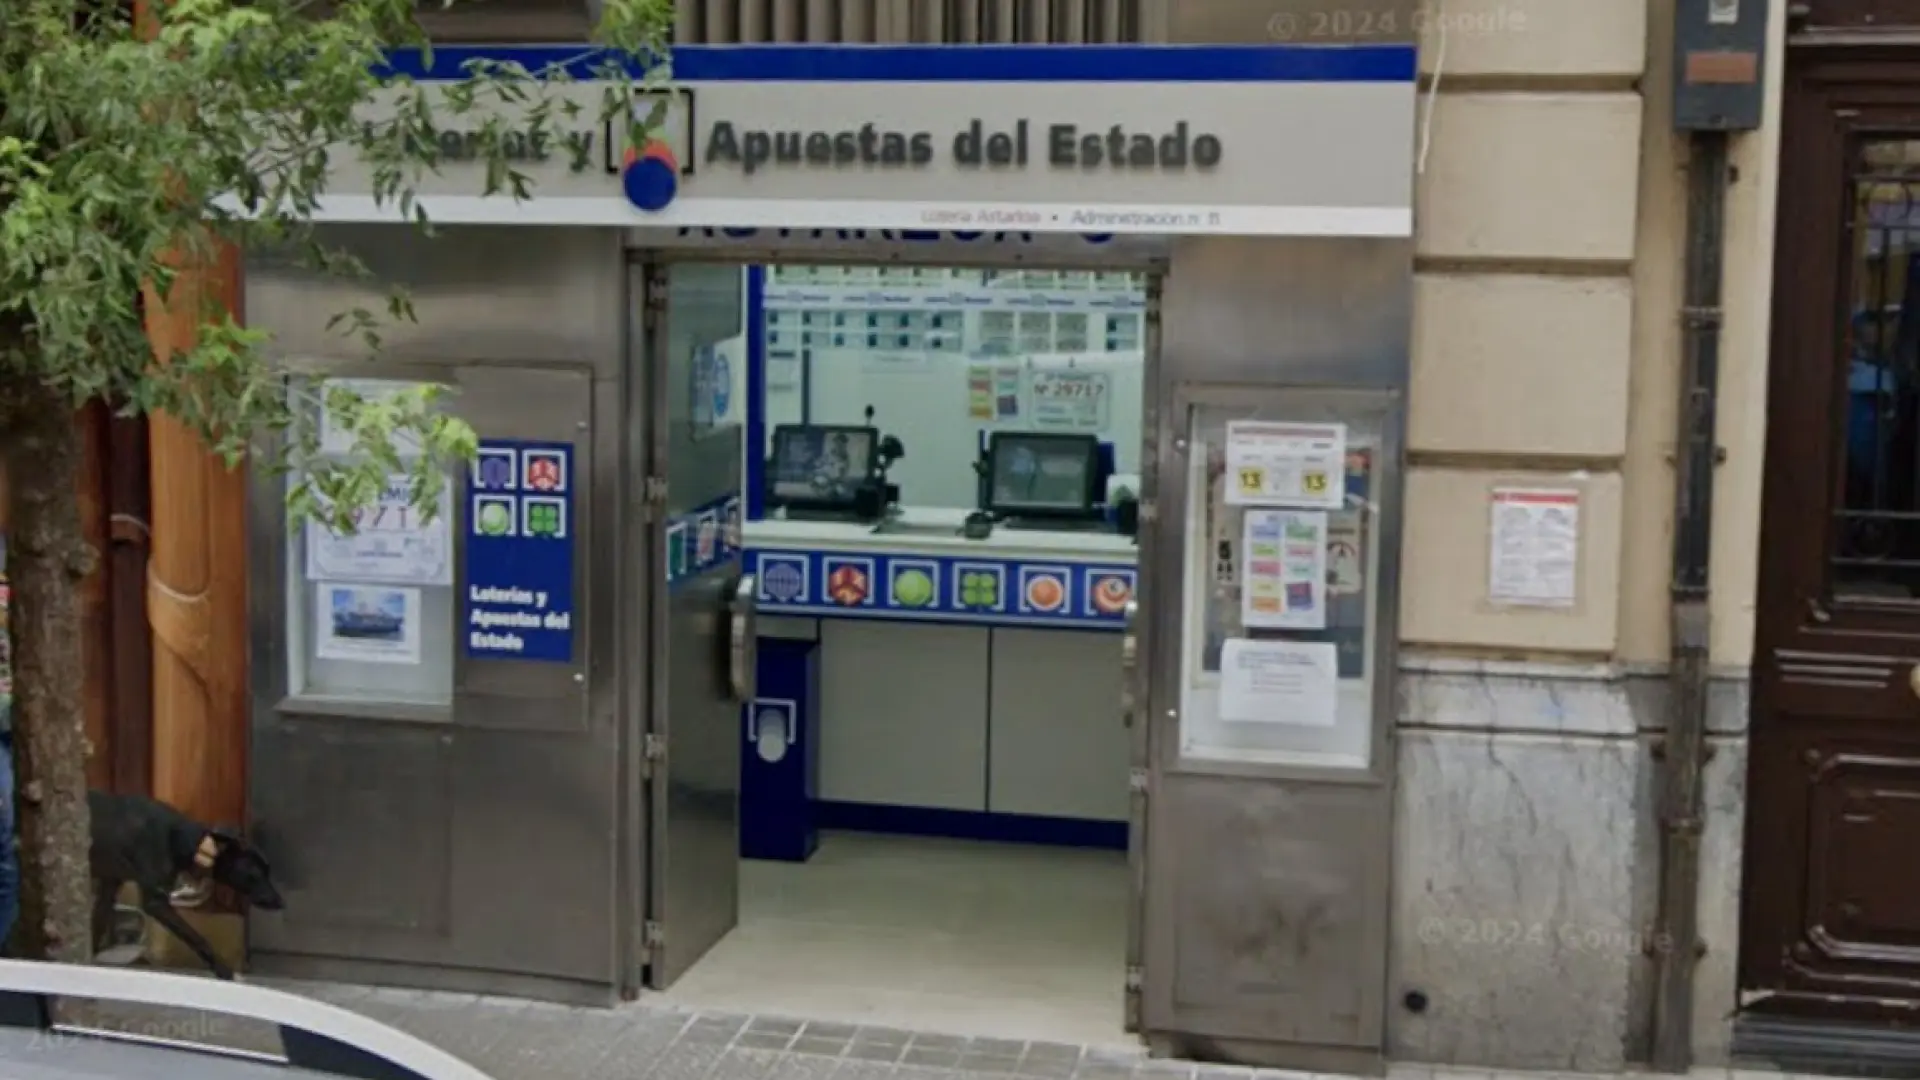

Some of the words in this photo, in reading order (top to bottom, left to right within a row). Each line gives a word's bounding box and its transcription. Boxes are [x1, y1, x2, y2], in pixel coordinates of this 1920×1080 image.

[706, 121, 933, 173] Apuestas
[953, 120, 1028, 166] del
[1050, 121, 1222, 168] Estado
[470, 608, 540, 629] Apuestas
[544, 610, 570, 629] del
[470, 631, 524, 652] Estado
